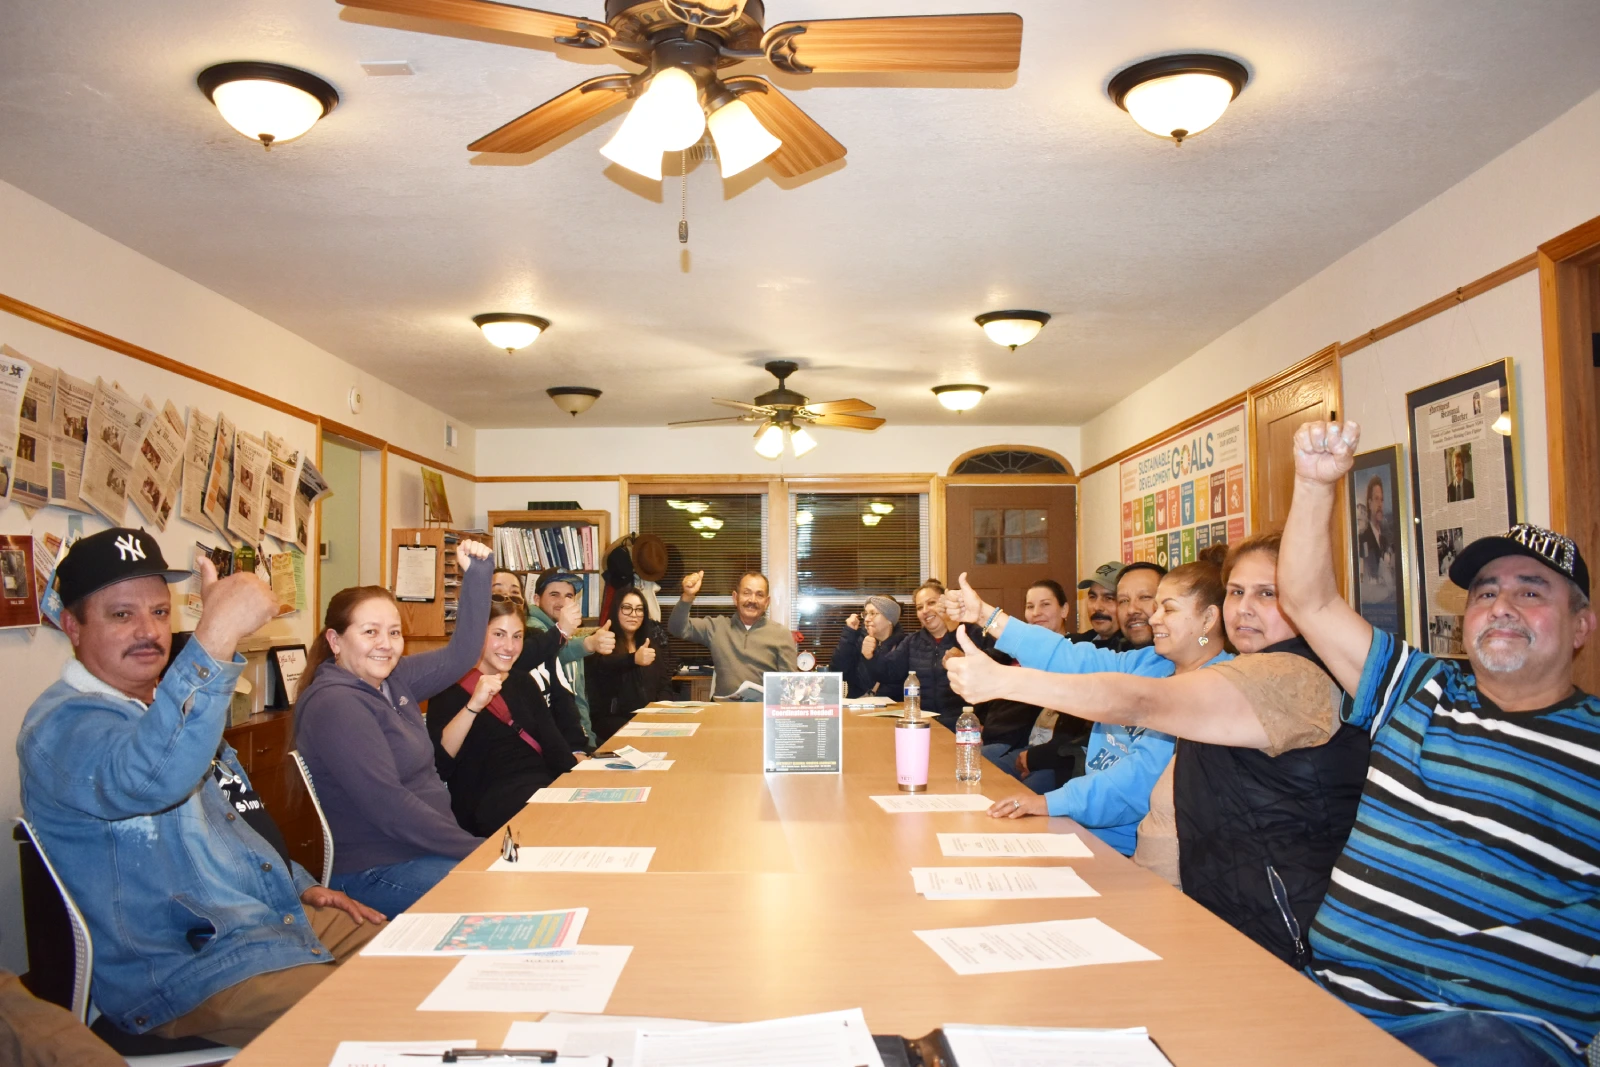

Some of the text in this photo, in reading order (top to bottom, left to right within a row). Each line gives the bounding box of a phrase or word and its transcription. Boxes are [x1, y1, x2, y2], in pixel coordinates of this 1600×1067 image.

[1138, 449, 1171, 476] SUSTAINABLE
[1171, 432, 1214, 480] GOALS
[1138, 467, 1171, 492] DEVELOPMENT
[114, 533, 147, 561] NY
